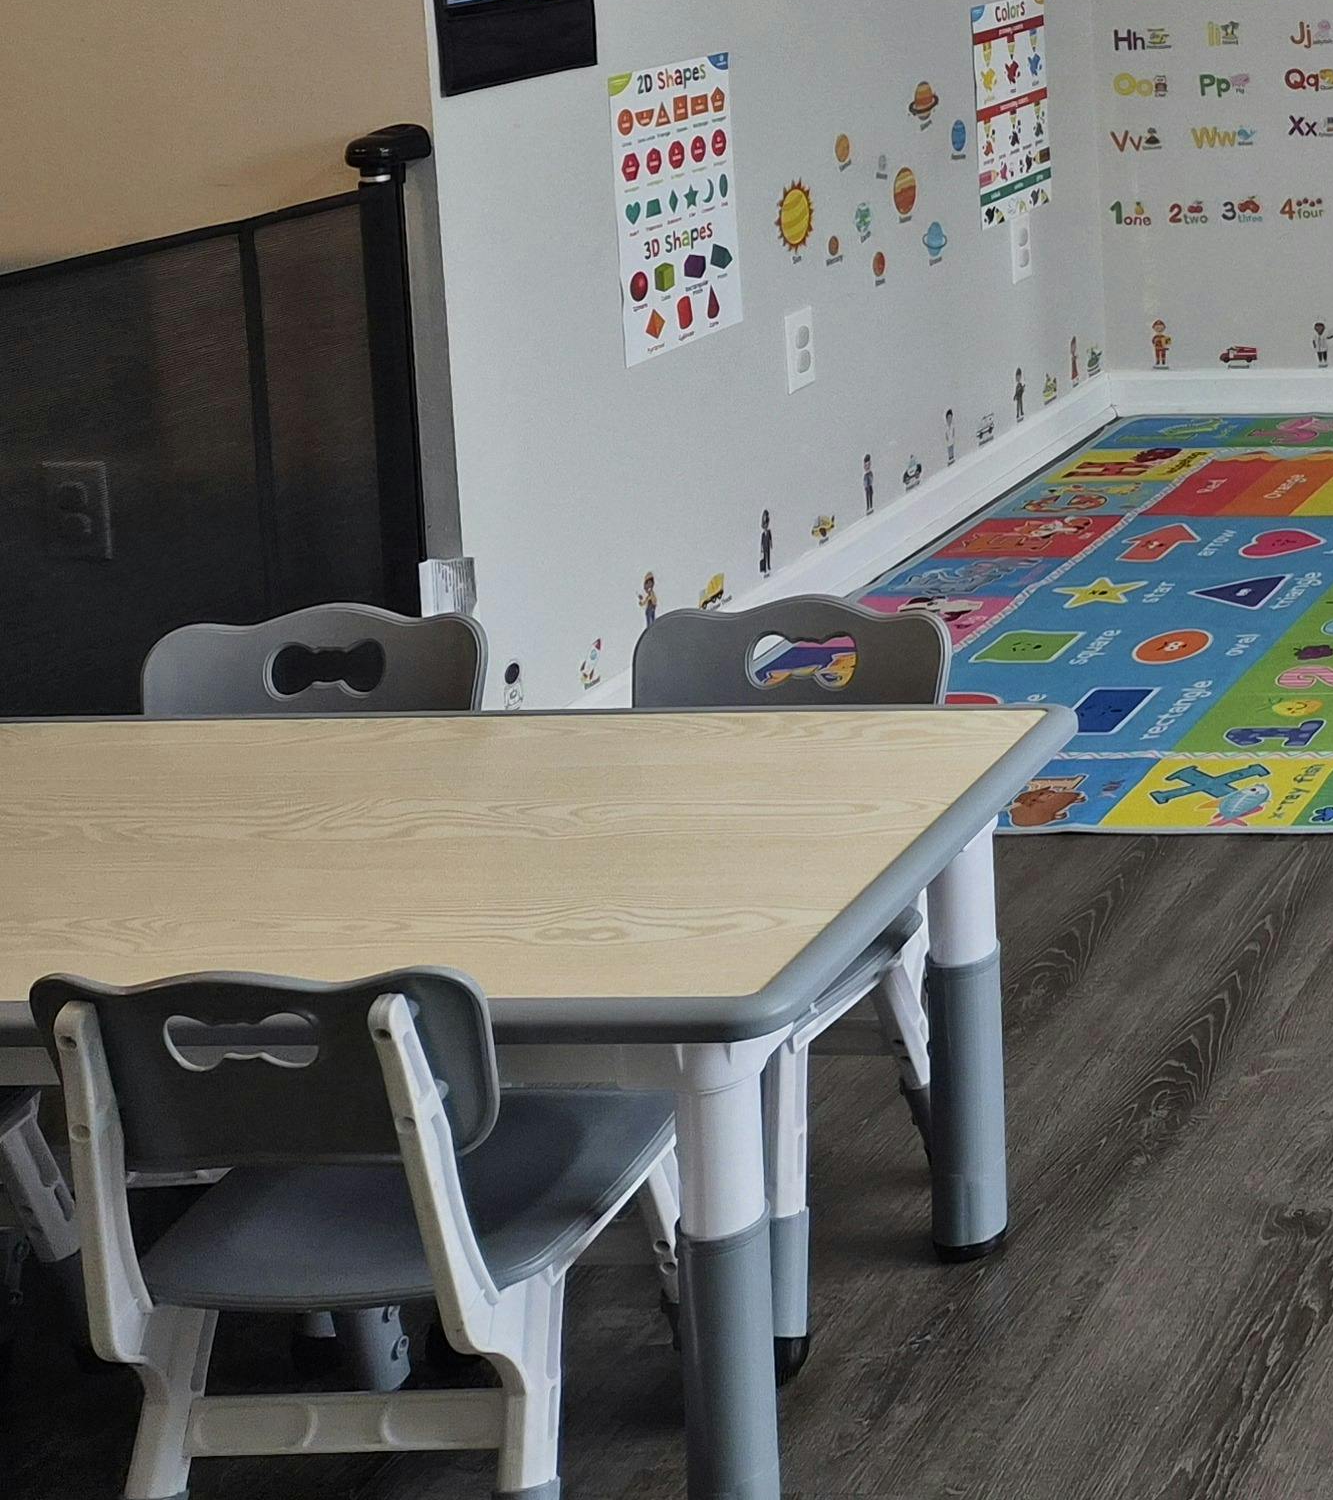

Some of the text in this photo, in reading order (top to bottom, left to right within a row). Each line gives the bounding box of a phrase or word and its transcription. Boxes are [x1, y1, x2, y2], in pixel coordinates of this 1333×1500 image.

[995, 2, 1026, 23] Colors
[1113, 28, 1146, 51] Hh
[636, 63, 707, 95] 2D Shapes
[1199, 68, 1320, 98] Pp Qq
[1288, 115, 1318, 137] Xx
[1109, 200, 1152, 227] 1 one
[1297, 206, 1324, 219] four
[643, 222, 713, 260] 3D Shapes
[1142, 581, 1176, 604] star
[1269, 571, 1324, 611] triangle
[1069, 628, 1122, 666] square
[1225, 633, 1261, 657] oval
[1140, 679, 1214, 741] rectangle
